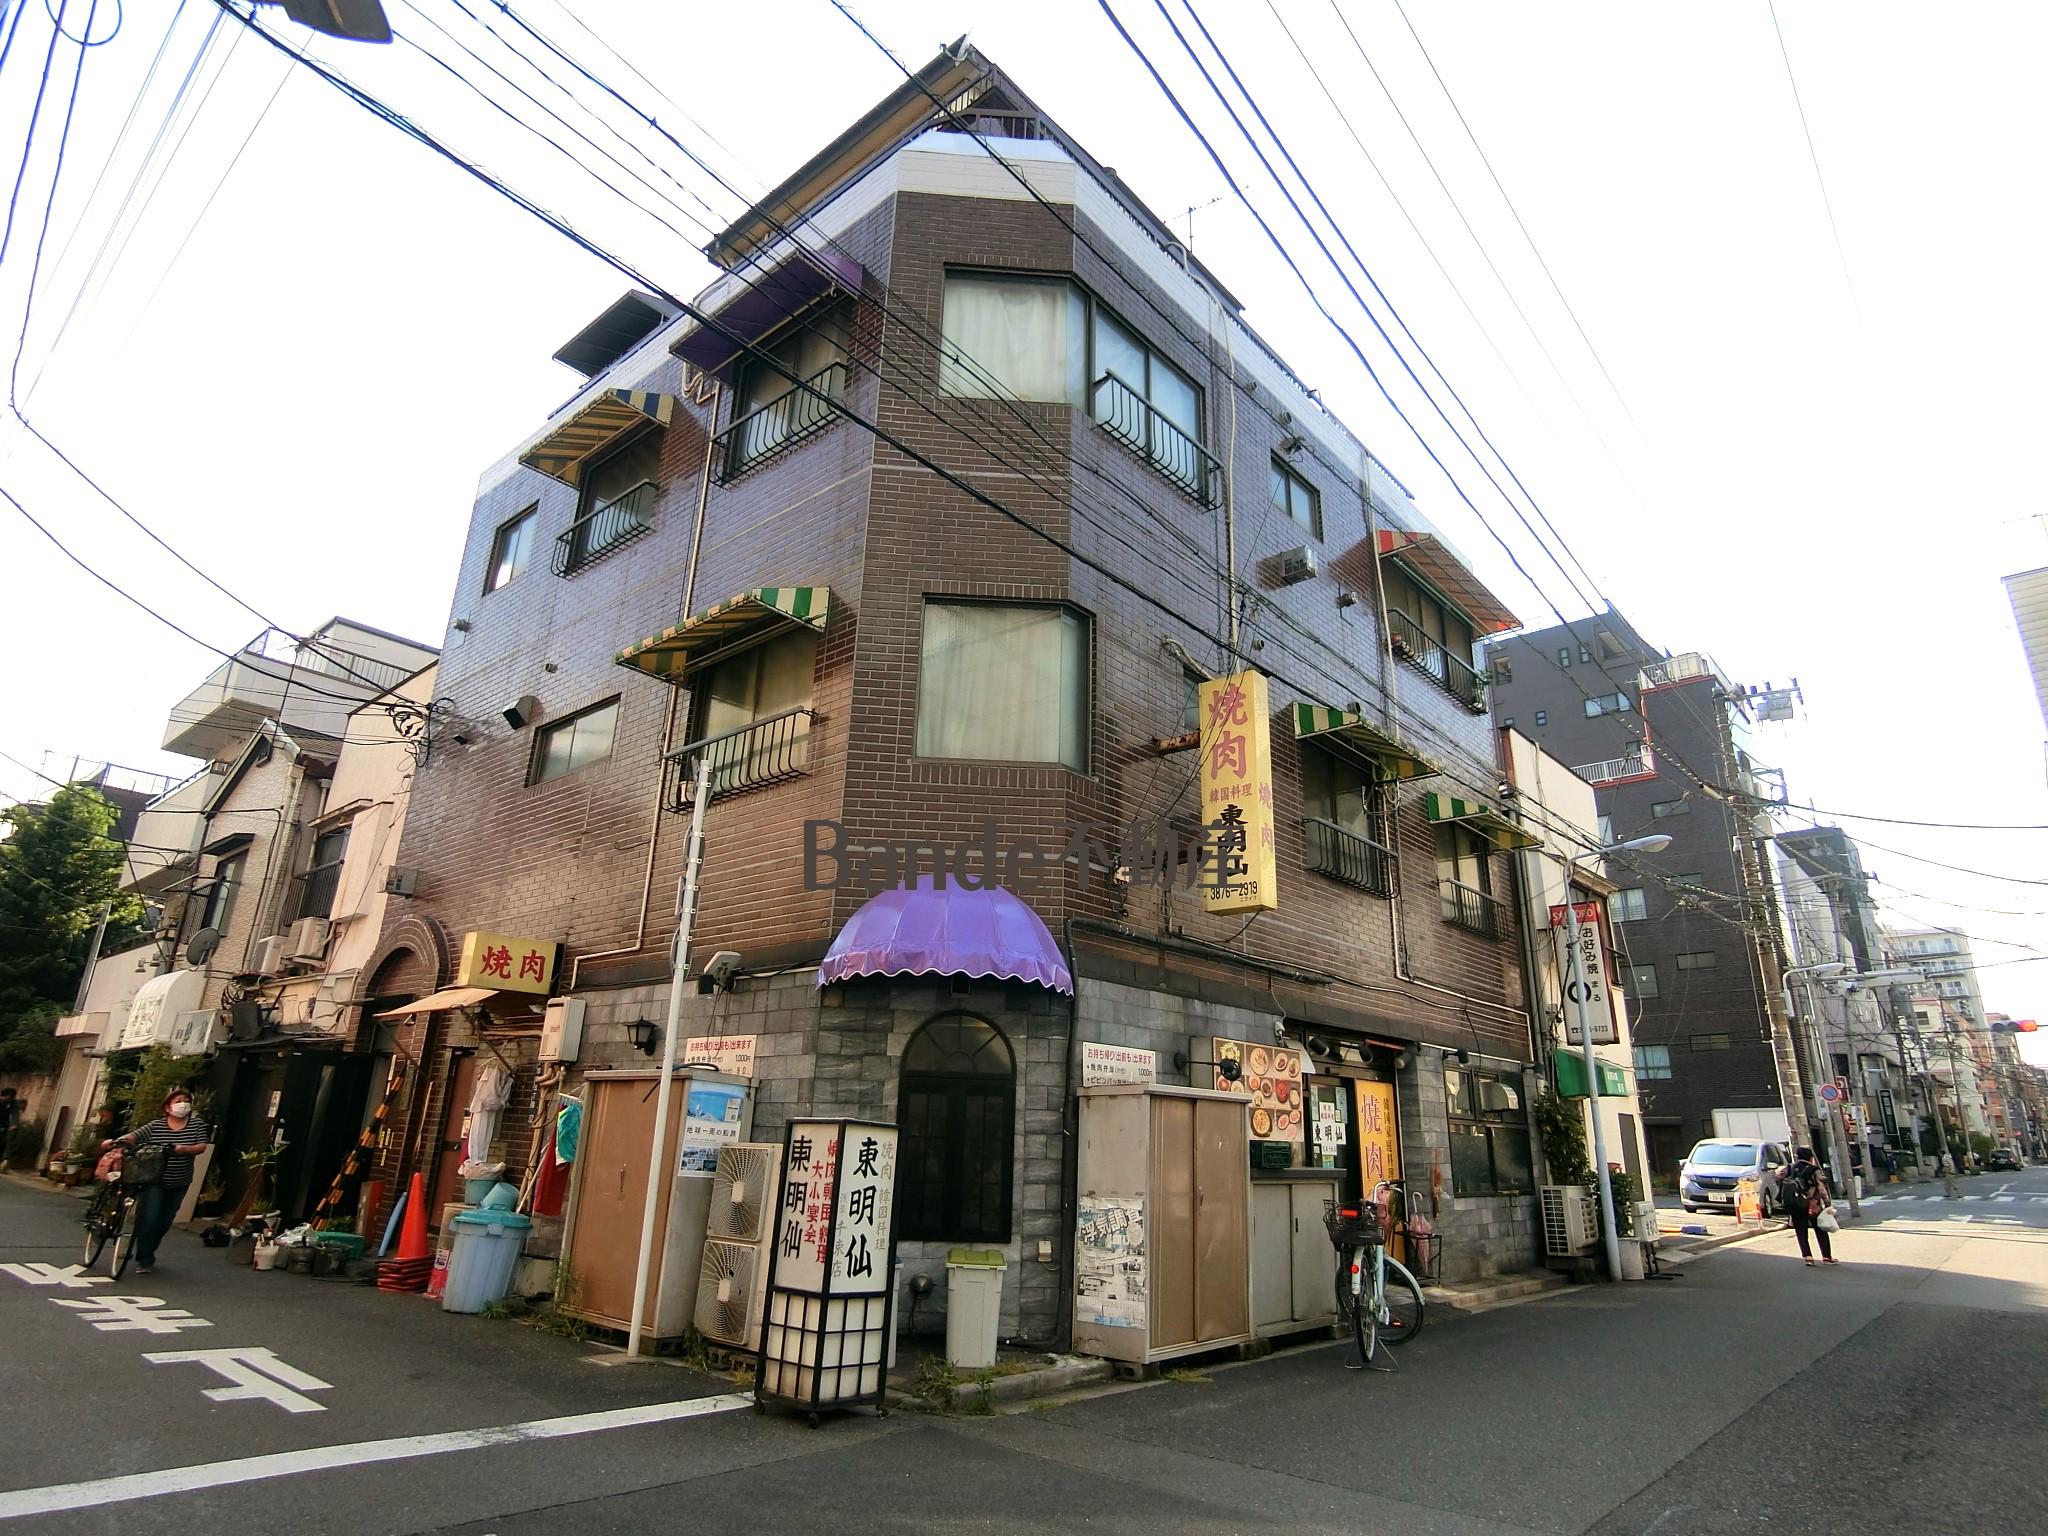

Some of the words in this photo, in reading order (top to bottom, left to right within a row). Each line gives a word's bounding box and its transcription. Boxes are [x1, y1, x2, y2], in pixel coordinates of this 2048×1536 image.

[1208, 682, 1249, 780] 焼肉
[1208, 783, 1254, 801] 韓国料理
[1258, 781, 1274, 849] 焼肉
[480, 945, 546, 983] 焼肉
[1581, 927, 1600, 975] お好み焼
[1591, 980, 1601, 1002] まる
[1314, 1123, 1343, 1142] 東明仙
[1361, 1093, 1384, 1182] 焼肉
[780, 1135, 813, 1259] 東明仙
[803, 1160, 824, 1245] 大小宴会
[844, 1137, 879, 1279] 東明仙
